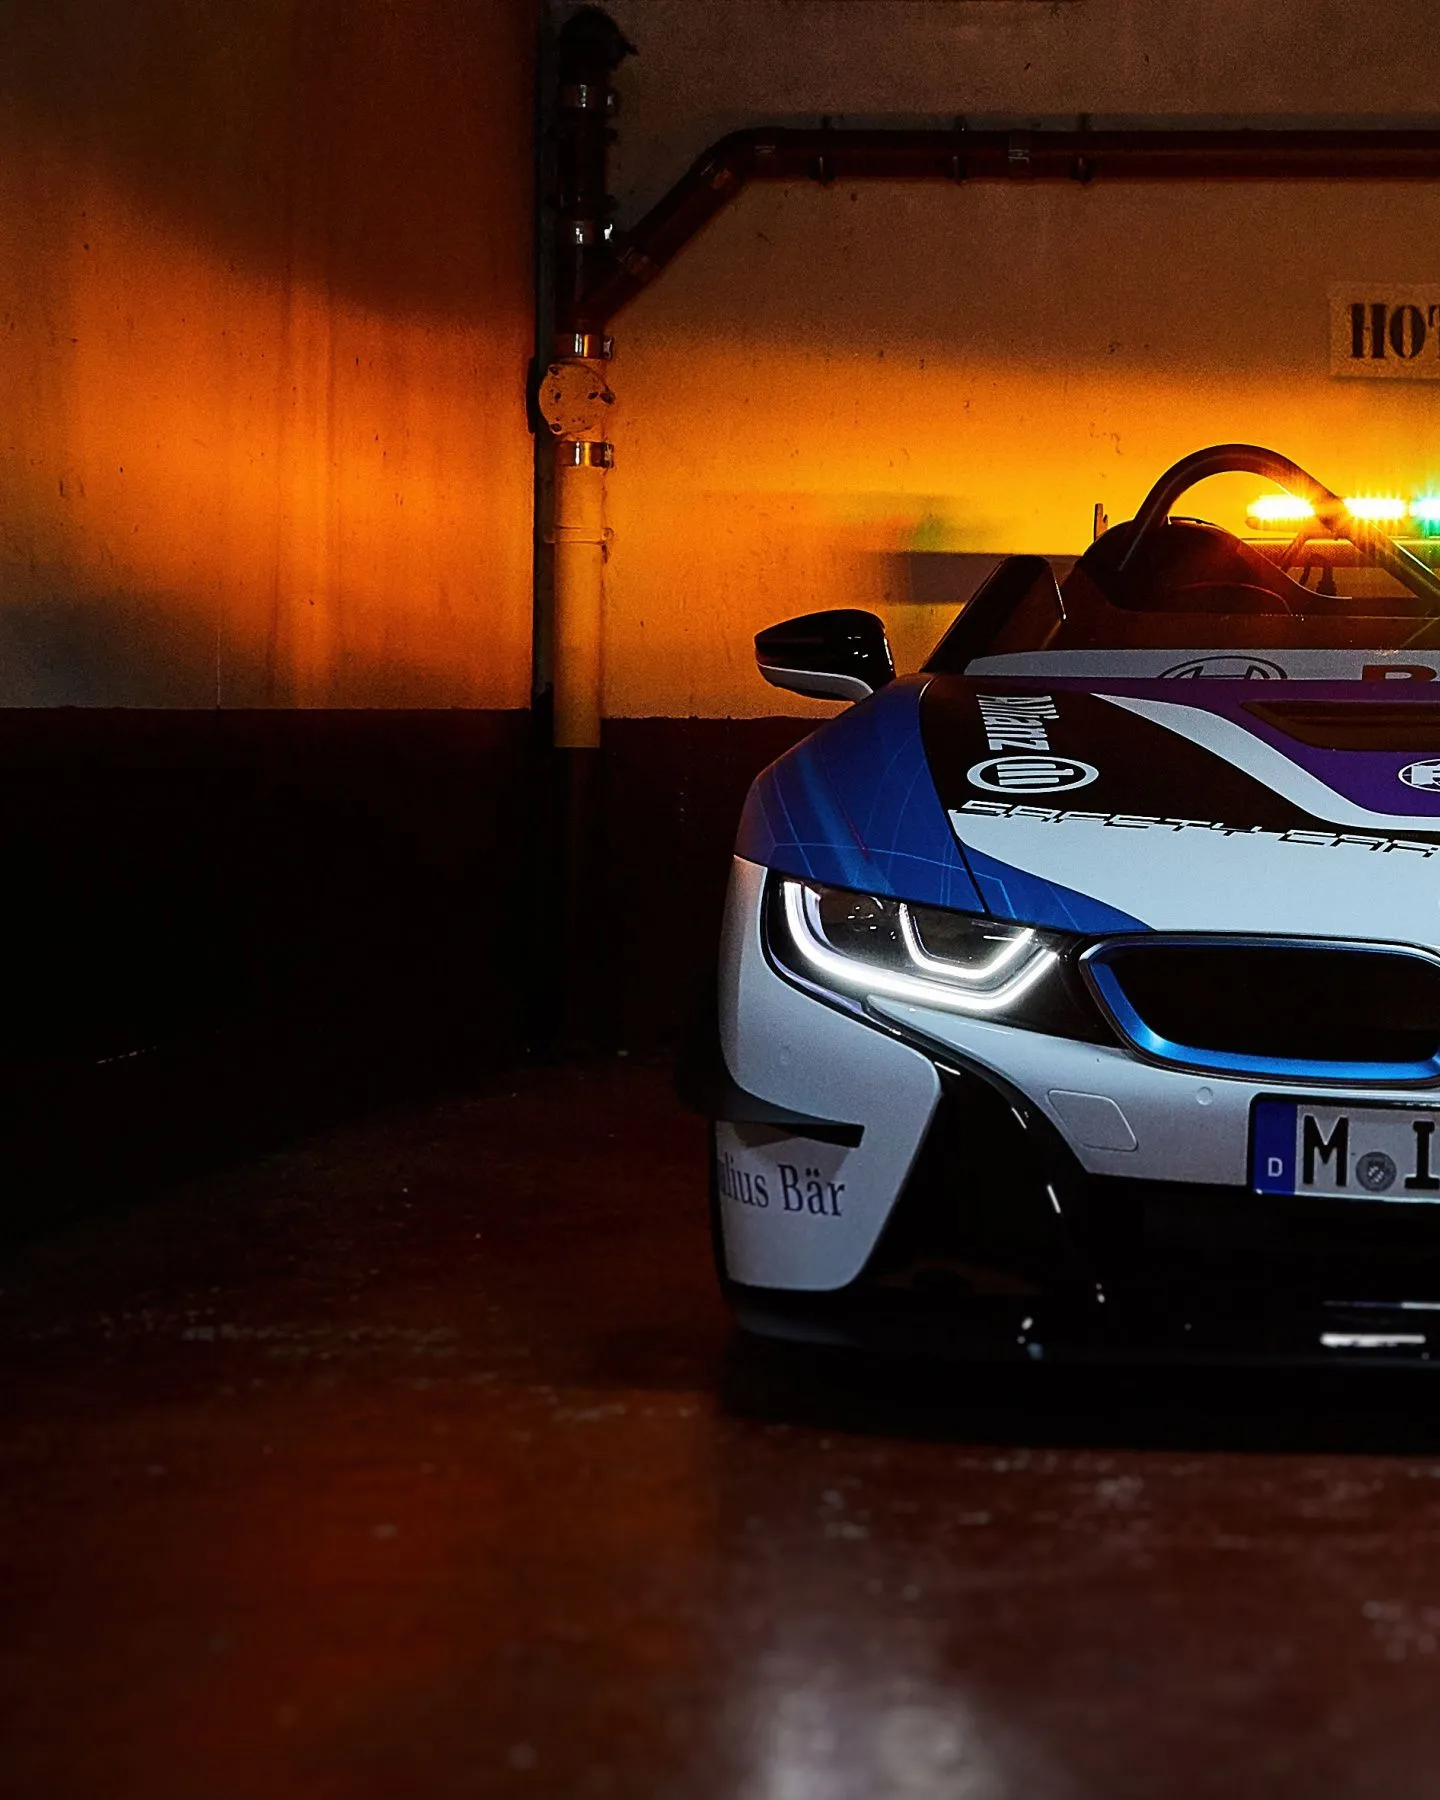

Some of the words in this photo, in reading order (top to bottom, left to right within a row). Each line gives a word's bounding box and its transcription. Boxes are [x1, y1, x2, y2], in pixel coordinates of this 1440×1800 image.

[976, 694, 1060, 751] Allianz
[1267, 1156, 1284, 1178] D
[1302, 1115, 1349, 1187] M
[722, 1151, 769, 1208] lius
[776, 1163, 845, 1217] Bär
